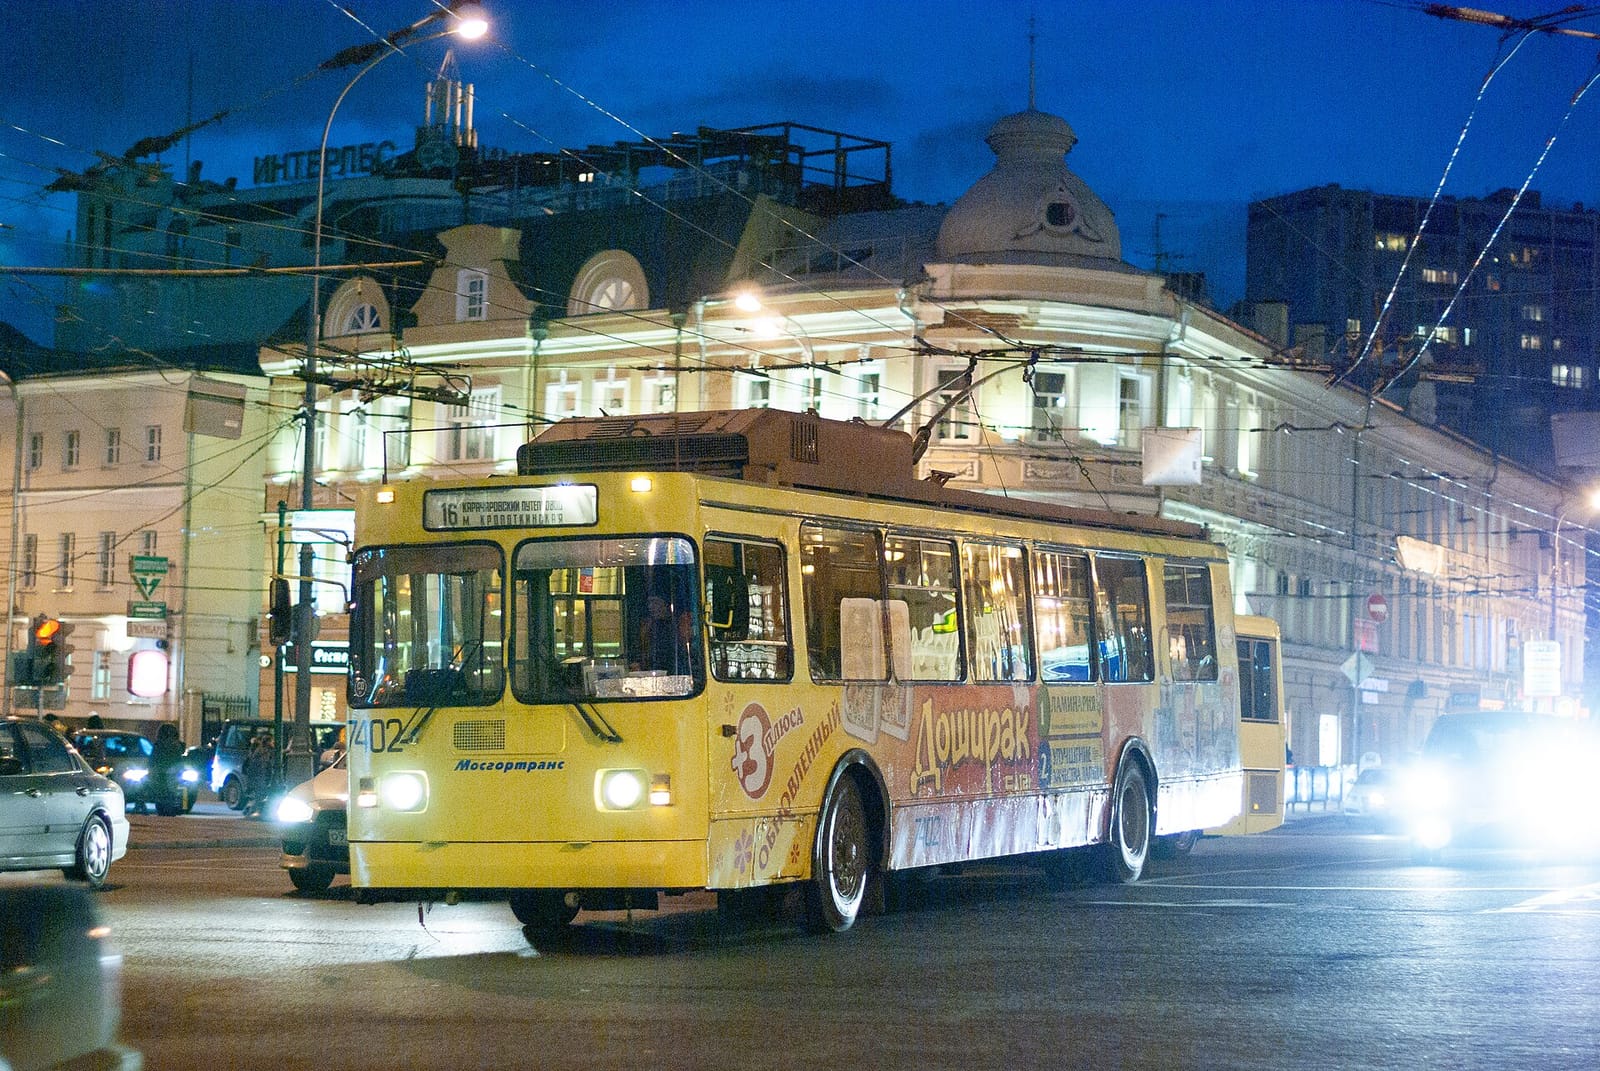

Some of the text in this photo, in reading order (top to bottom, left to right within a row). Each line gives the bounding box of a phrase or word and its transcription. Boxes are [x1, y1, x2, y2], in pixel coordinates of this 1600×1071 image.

[253, 140, 397, 185] ИНТЕРЛЕС
[441, 503, 458, 526] 16
[348, 718, 404, 753] 7402
[764, 706, 805, 757] ПЛЮСА
[911, 698, 1030, 797] Доширак
[454, 759, 565, 773] Мосгортранс
[758, 700, 842, 870] ОБНОВЛЕННЫЙ
